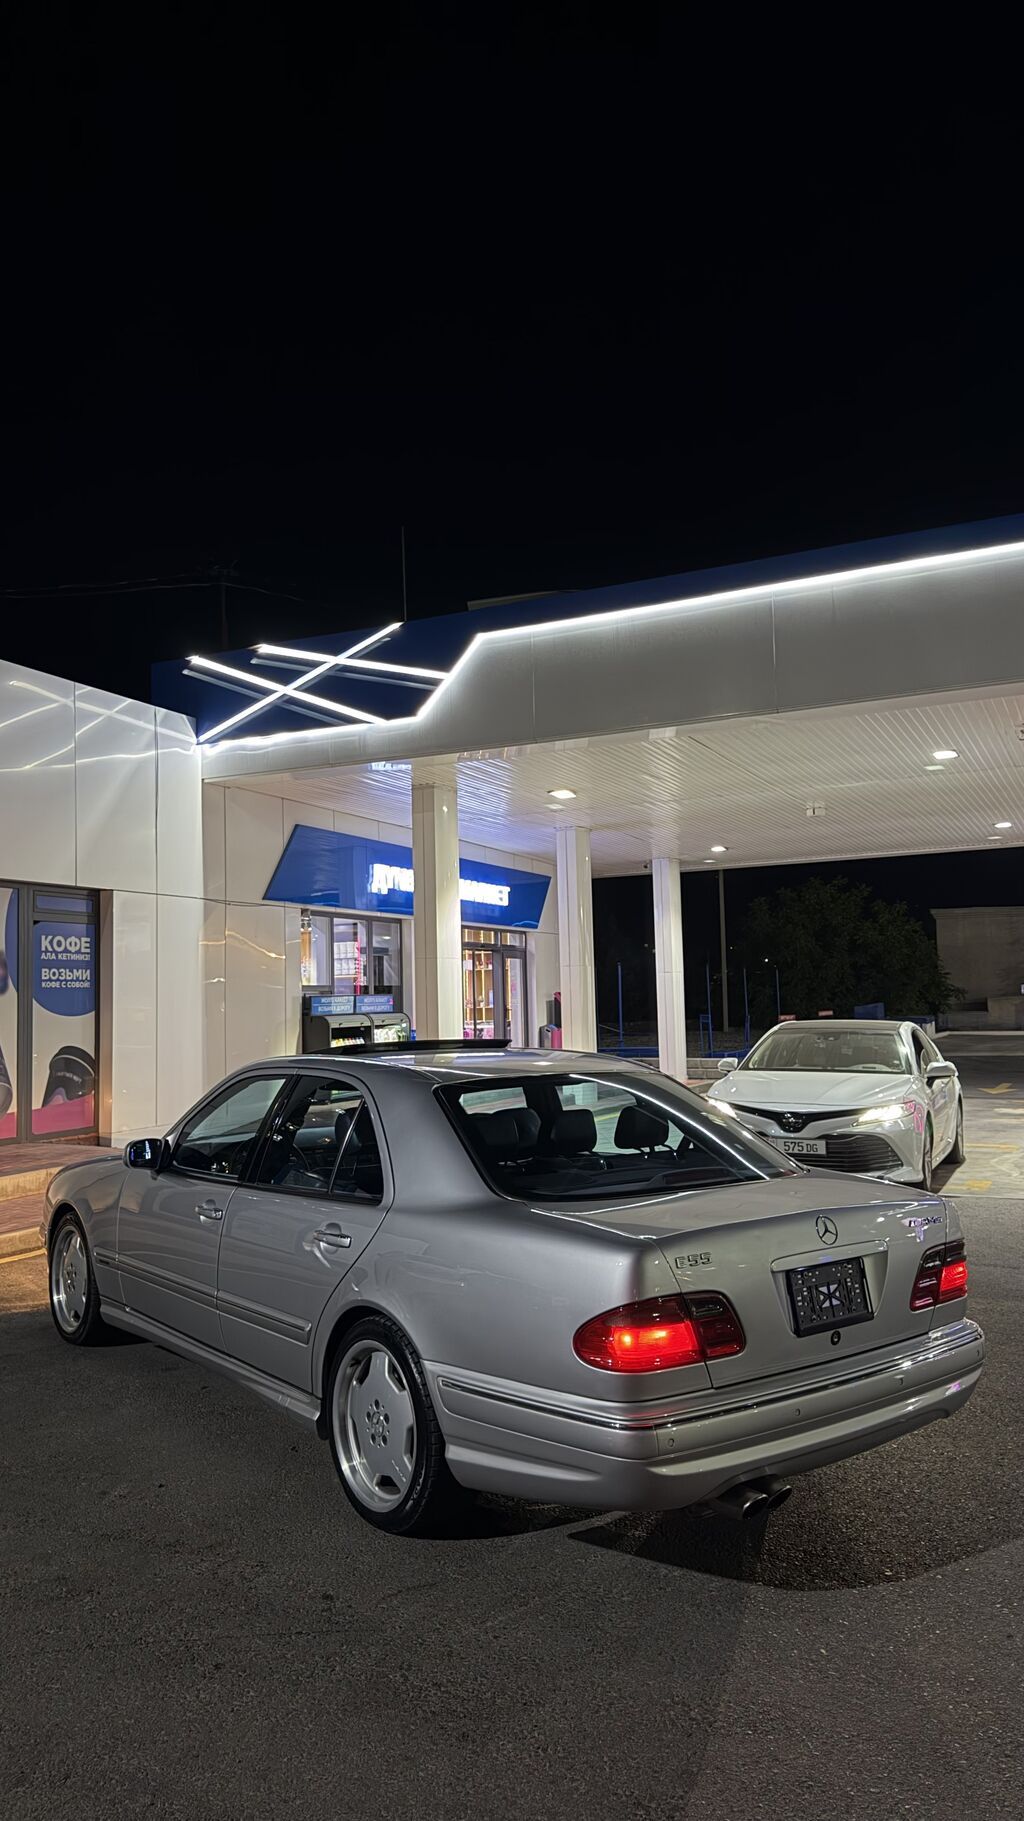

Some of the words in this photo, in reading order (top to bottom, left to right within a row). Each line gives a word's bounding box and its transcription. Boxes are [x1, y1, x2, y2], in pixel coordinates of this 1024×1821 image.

[41, 935, 91, 953] КОФЕ
[41, 968, 90, 980] ВОЗЬМИ
[783, 1141, 804, 1153] 575
[806, 1144, 819, 1153] DG
[675, 1252, 713, 1269] E55
